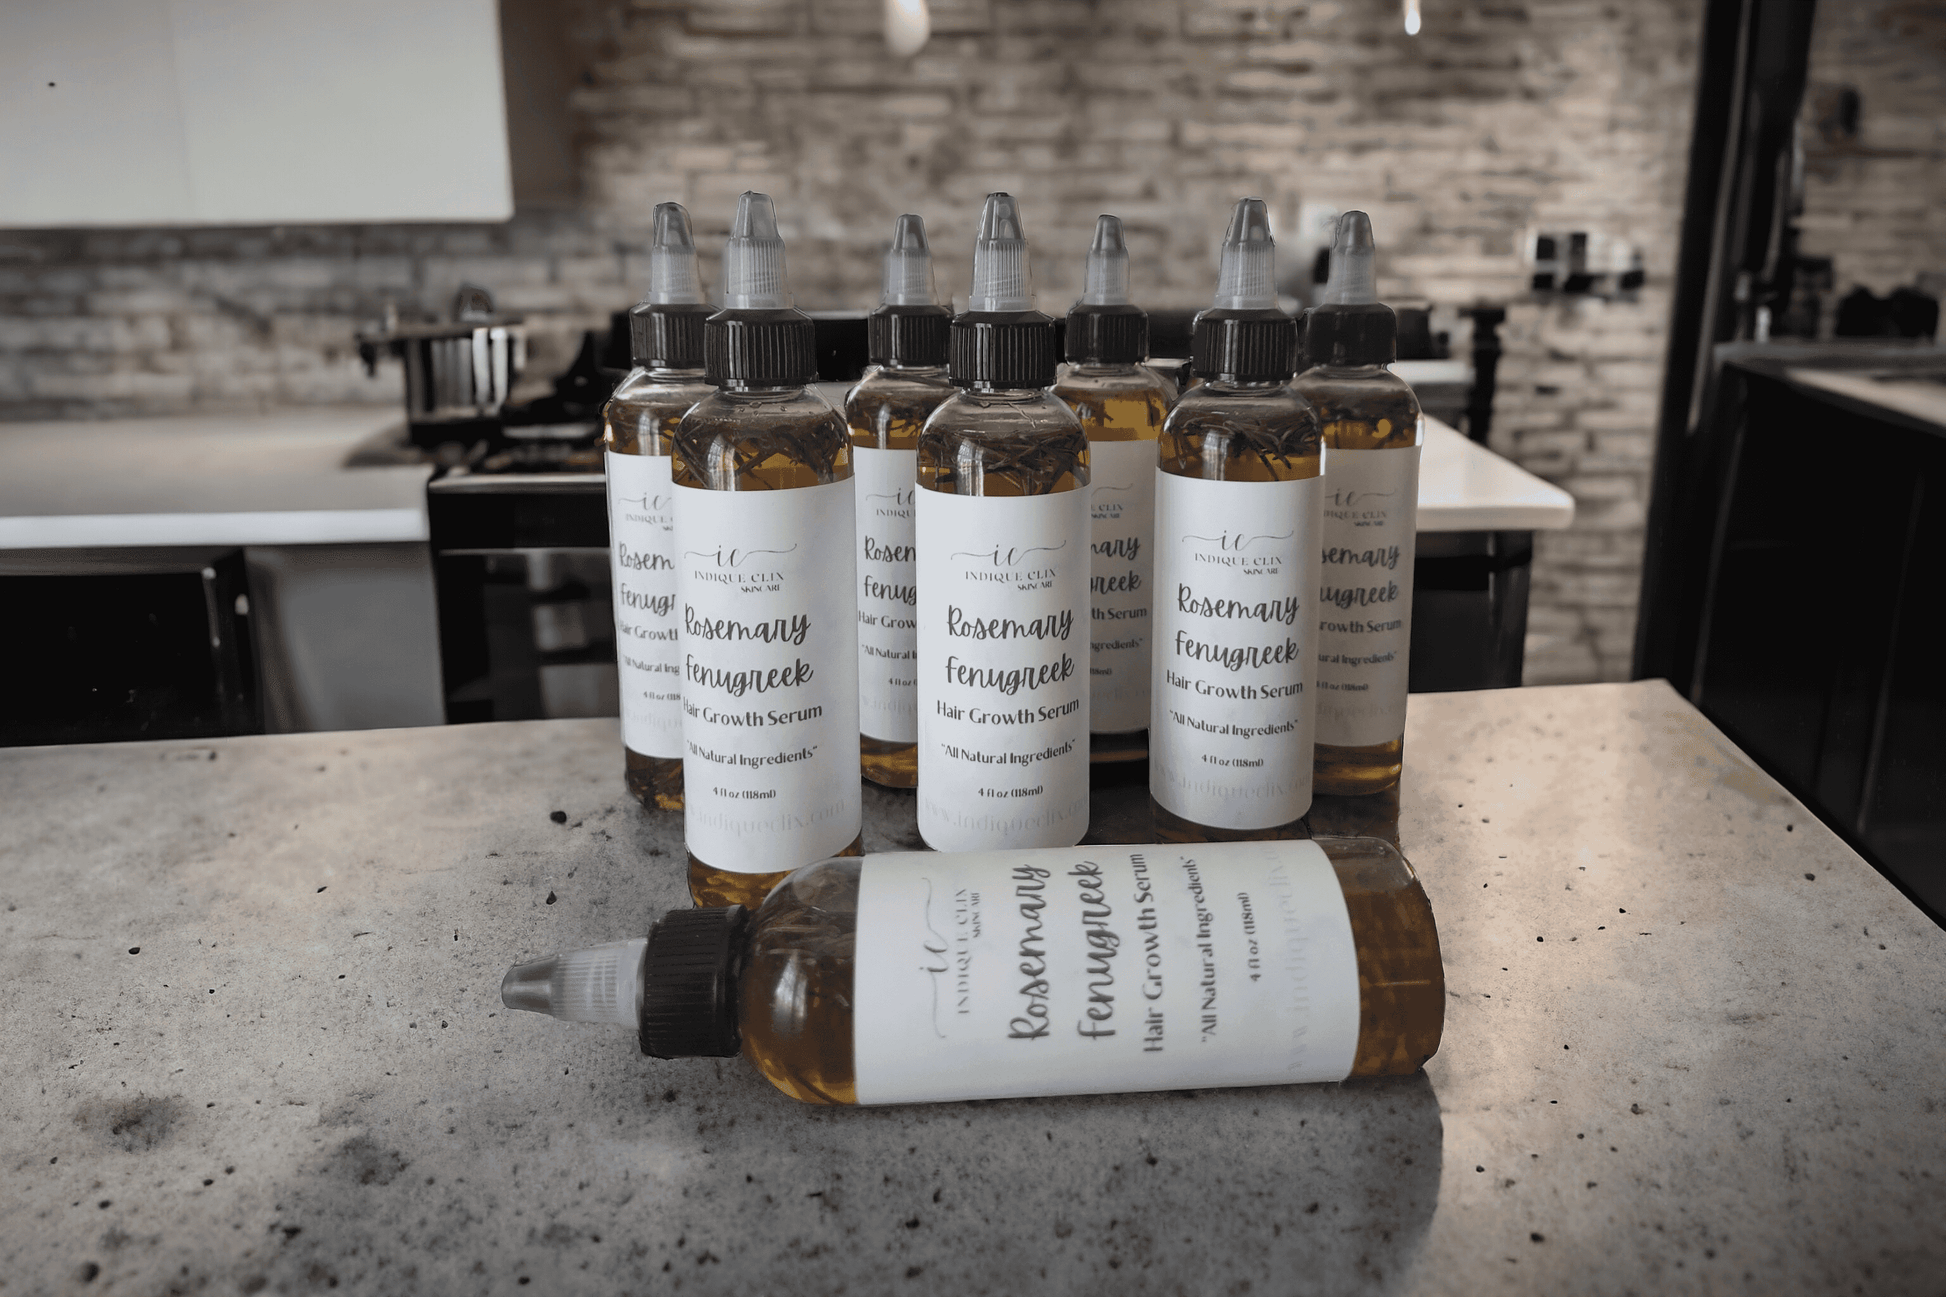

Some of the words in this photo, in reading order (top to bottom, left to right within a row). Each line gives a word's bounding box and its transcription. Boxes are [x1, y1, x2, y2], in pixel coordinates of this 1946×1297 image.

[876, 508, 916, 519] INDIQU
[619, 541, 675, 571] Rosem
[864, 535, 916, 563] Rosem
[1195, 552, 1249, 567] INDIQUE
[1253, 555, 1283, 566] CLIX
[1321, 546, 1400, 570] semary
[694, 570, 746, 585] INDIQUE
[750, 571, 785, 583] CLIX
[965, 569, 1023, 584] INDIQUE
[1027, 568, 1057, 581] CLIX
[1243, 568, 1279, 576] SKINCARE
[740, 584, 781, 593] SKINCARE
[863, 574, 917, 606] Fenug
[1017, 580, 1054, 592] SKINCARE
[1320, 580, 1399, 609] ugreek
[621, 583, 676, 617] Fenug
[1177, 583, 1300, 626] Rosemary
[685, 602, 811, 646] Rosemary
[858, 610, 878, 626] Hair
[880, 615, 917, 629] Grow
[946, 604, 1075, 641] Rosemary
[1107, 608, 1147, 620] Serum
[1318, 620, 1364, 633] rowth
[1366, 619, 1402, 633] Serum
[875, 648, 910, 660] Natural
[1090, 638, 1143, 652] ngredients"
[1175, 630, 1300, 672] Fenugreek
[1318, 653, 1339, 664] ural
[686, 654, 815, 698] Fenugreek
[945, 652, 1076, 696] Fenugreek
[1166, 669, 1192, 691] Hair
[1195, 679, 1257, 701] Growth
[1260, 681, 1303, 700] Serum
[683, 696, 701, 719] Hair
[703, 707, 764, 727] Growth
[767, 705, 823, 727] Serum
[936, 699, 966, 720] Hair
[968, 708, 1036, 726] Growth
[1037, 698, 1080, 722] Serum
[1186, 715, 1230, 736] Natural
[698, 746, 737, 766] Natural
[960, 749, 1007, 765] Natural
[1201, 754, 1208, 763] 4
[1209, 756, 1218, 766] fl
[1218, 758, 1231, 767] oz
[1232, 757, 1264, 768] (118ml)
[712, 786, 719, 796] 4
[719, 787, 728, 798] fl
[728, 790, 740, 799] oz
[742, 789, 777, 800] (118ml)
[978, 787, 985, 797] 4
[986, 788, 995, 798] fl
[996, 790, 1009, 799] oz
[1010, 785, 1044, 799] (118ml)
[1130, 853, 1154, 904] Serum
[955, 888, 968, 925] CLIX
[1236, 892, 1256, 935] (118ml)
[1007, 864, 1051, 1040] Rosemary
[1067, 860, 1121, 1040] Fenugreek
[1137, 907, 1164, 1001] Growth
[1248, 938, 1259, 956] oz
[956, 931, 973, 1014] INDIQUE
[1247, 957, 1261, 970] fl
[1197, 943, 1217, 1011] Natural
[1250, 973, 1262, 983] 4
[1143, 1006, 1164, 1053] Hair
